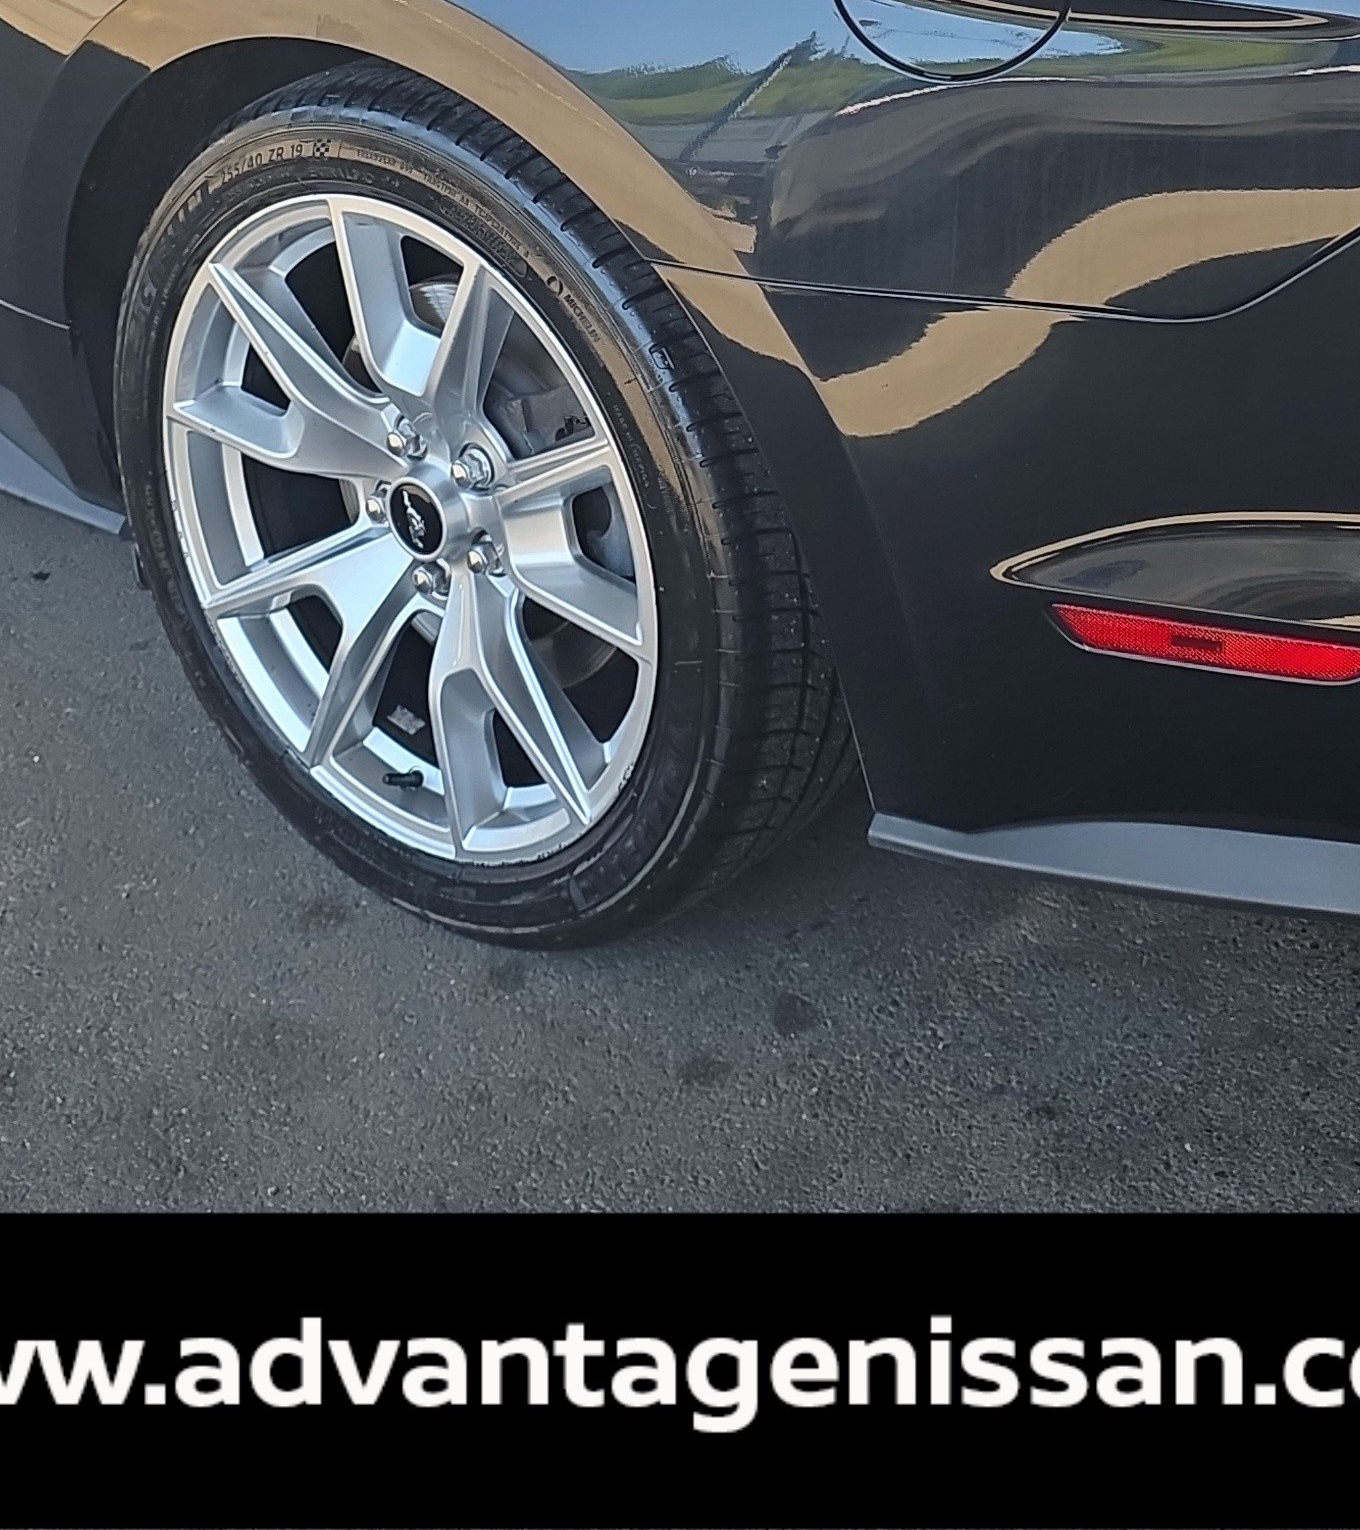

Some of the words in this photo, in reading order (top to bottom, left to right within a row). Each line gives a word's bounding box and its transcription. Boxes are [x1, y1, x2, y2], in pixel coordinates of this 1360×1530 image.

[221, 153, 263, 184] 255/40
[268, 146, 285, 163] ZR
[290, 143, 303, 157] 19
[562, 292, 601, 343] MICHELIN
